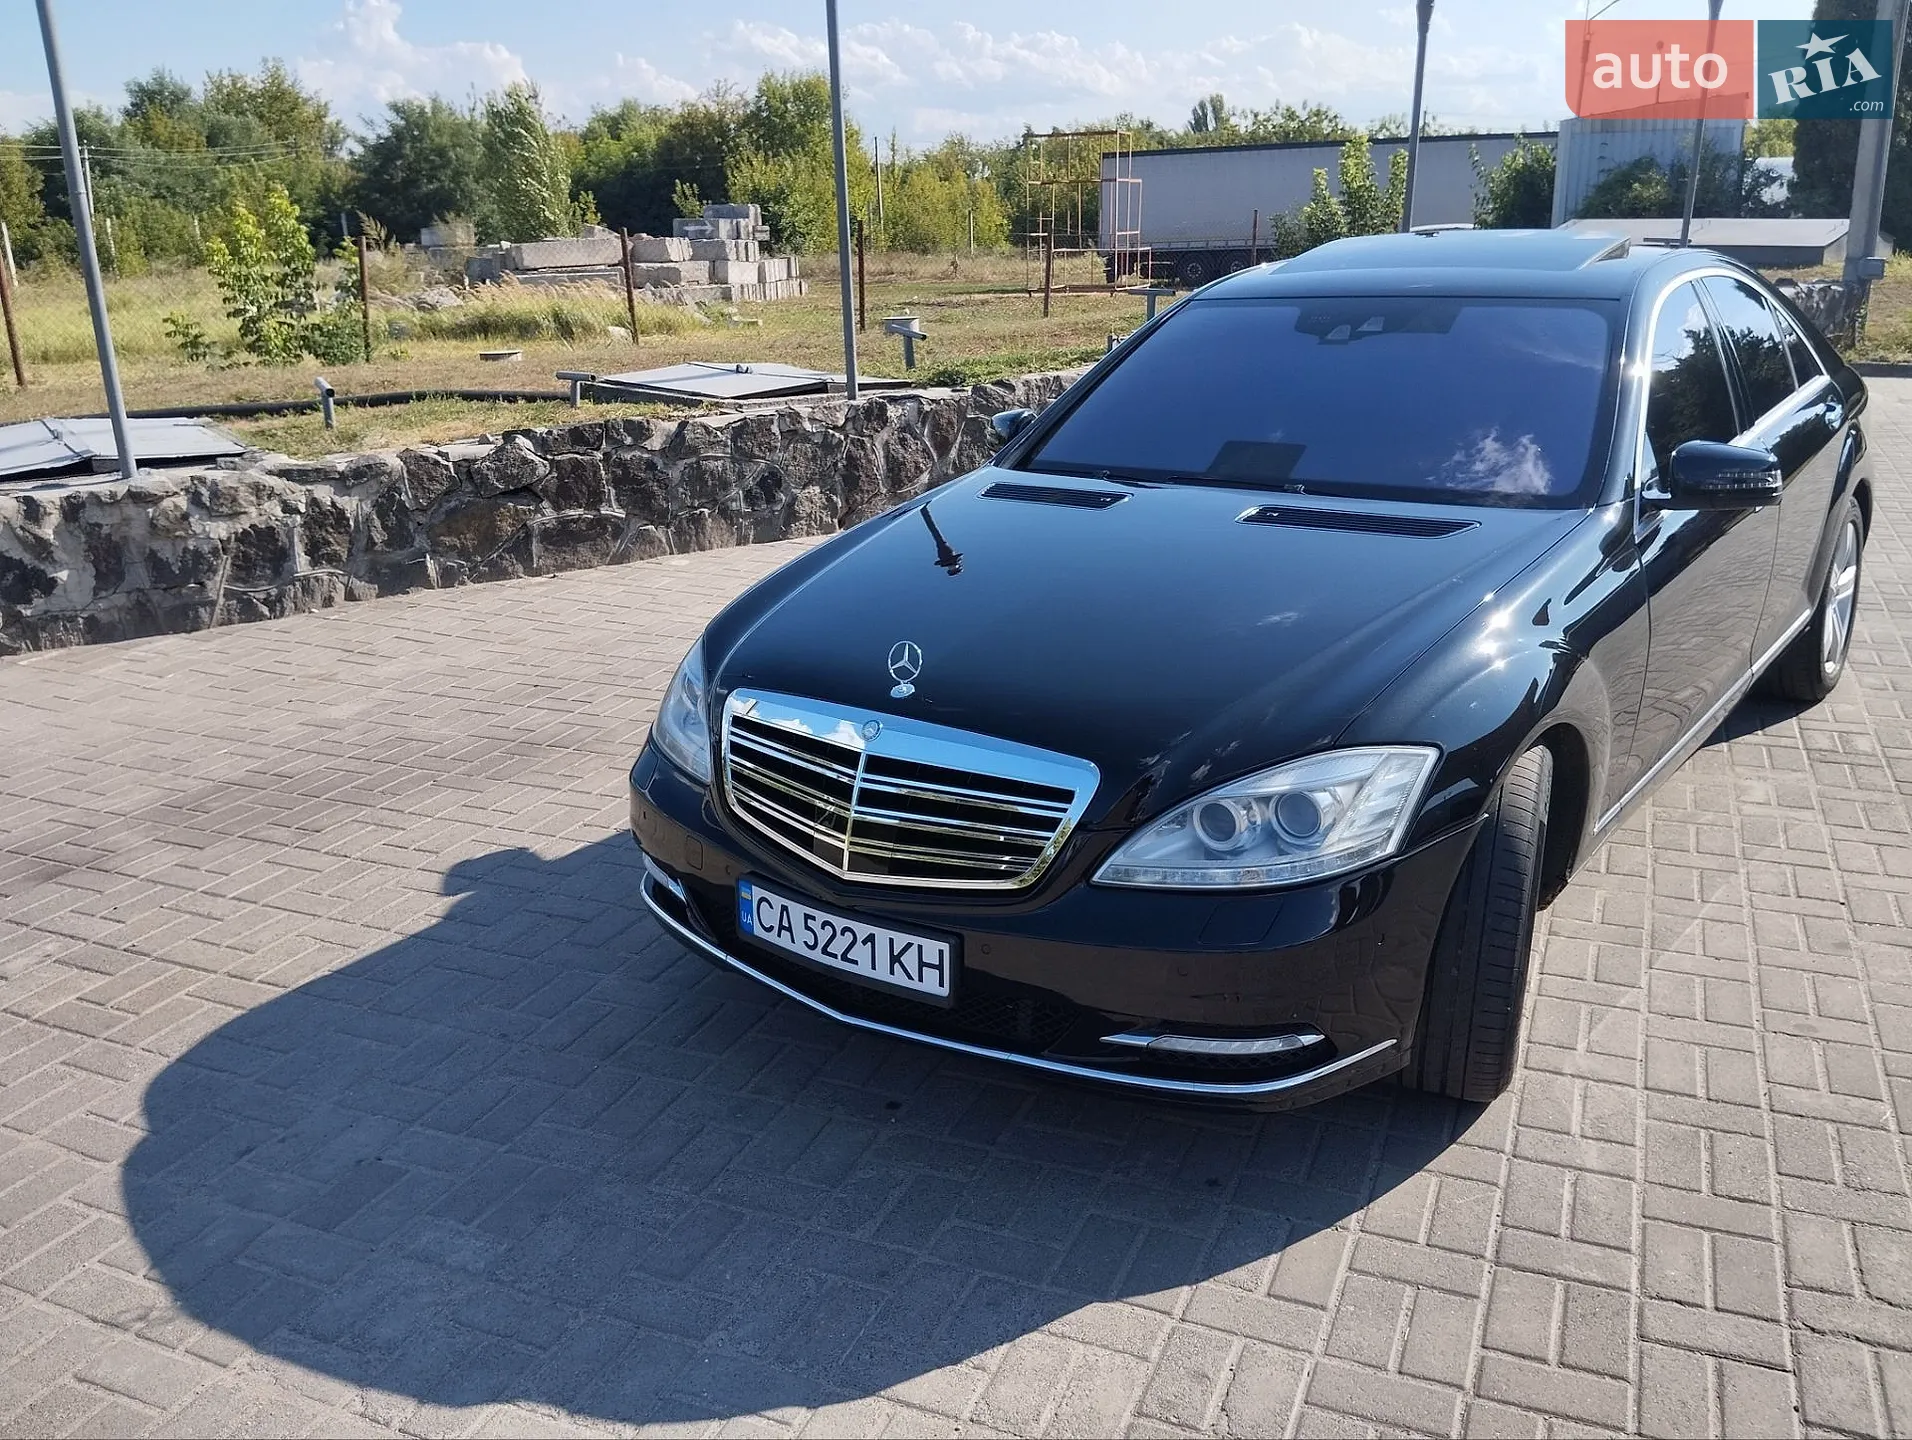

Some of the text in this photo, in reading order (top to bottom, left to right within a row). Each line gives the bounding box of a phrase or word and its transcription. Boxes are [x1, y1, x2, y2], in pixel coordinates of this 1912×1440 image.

[741, 910, 753, 925] UA
[756, 896, 945, 988] CA 5221 KH
